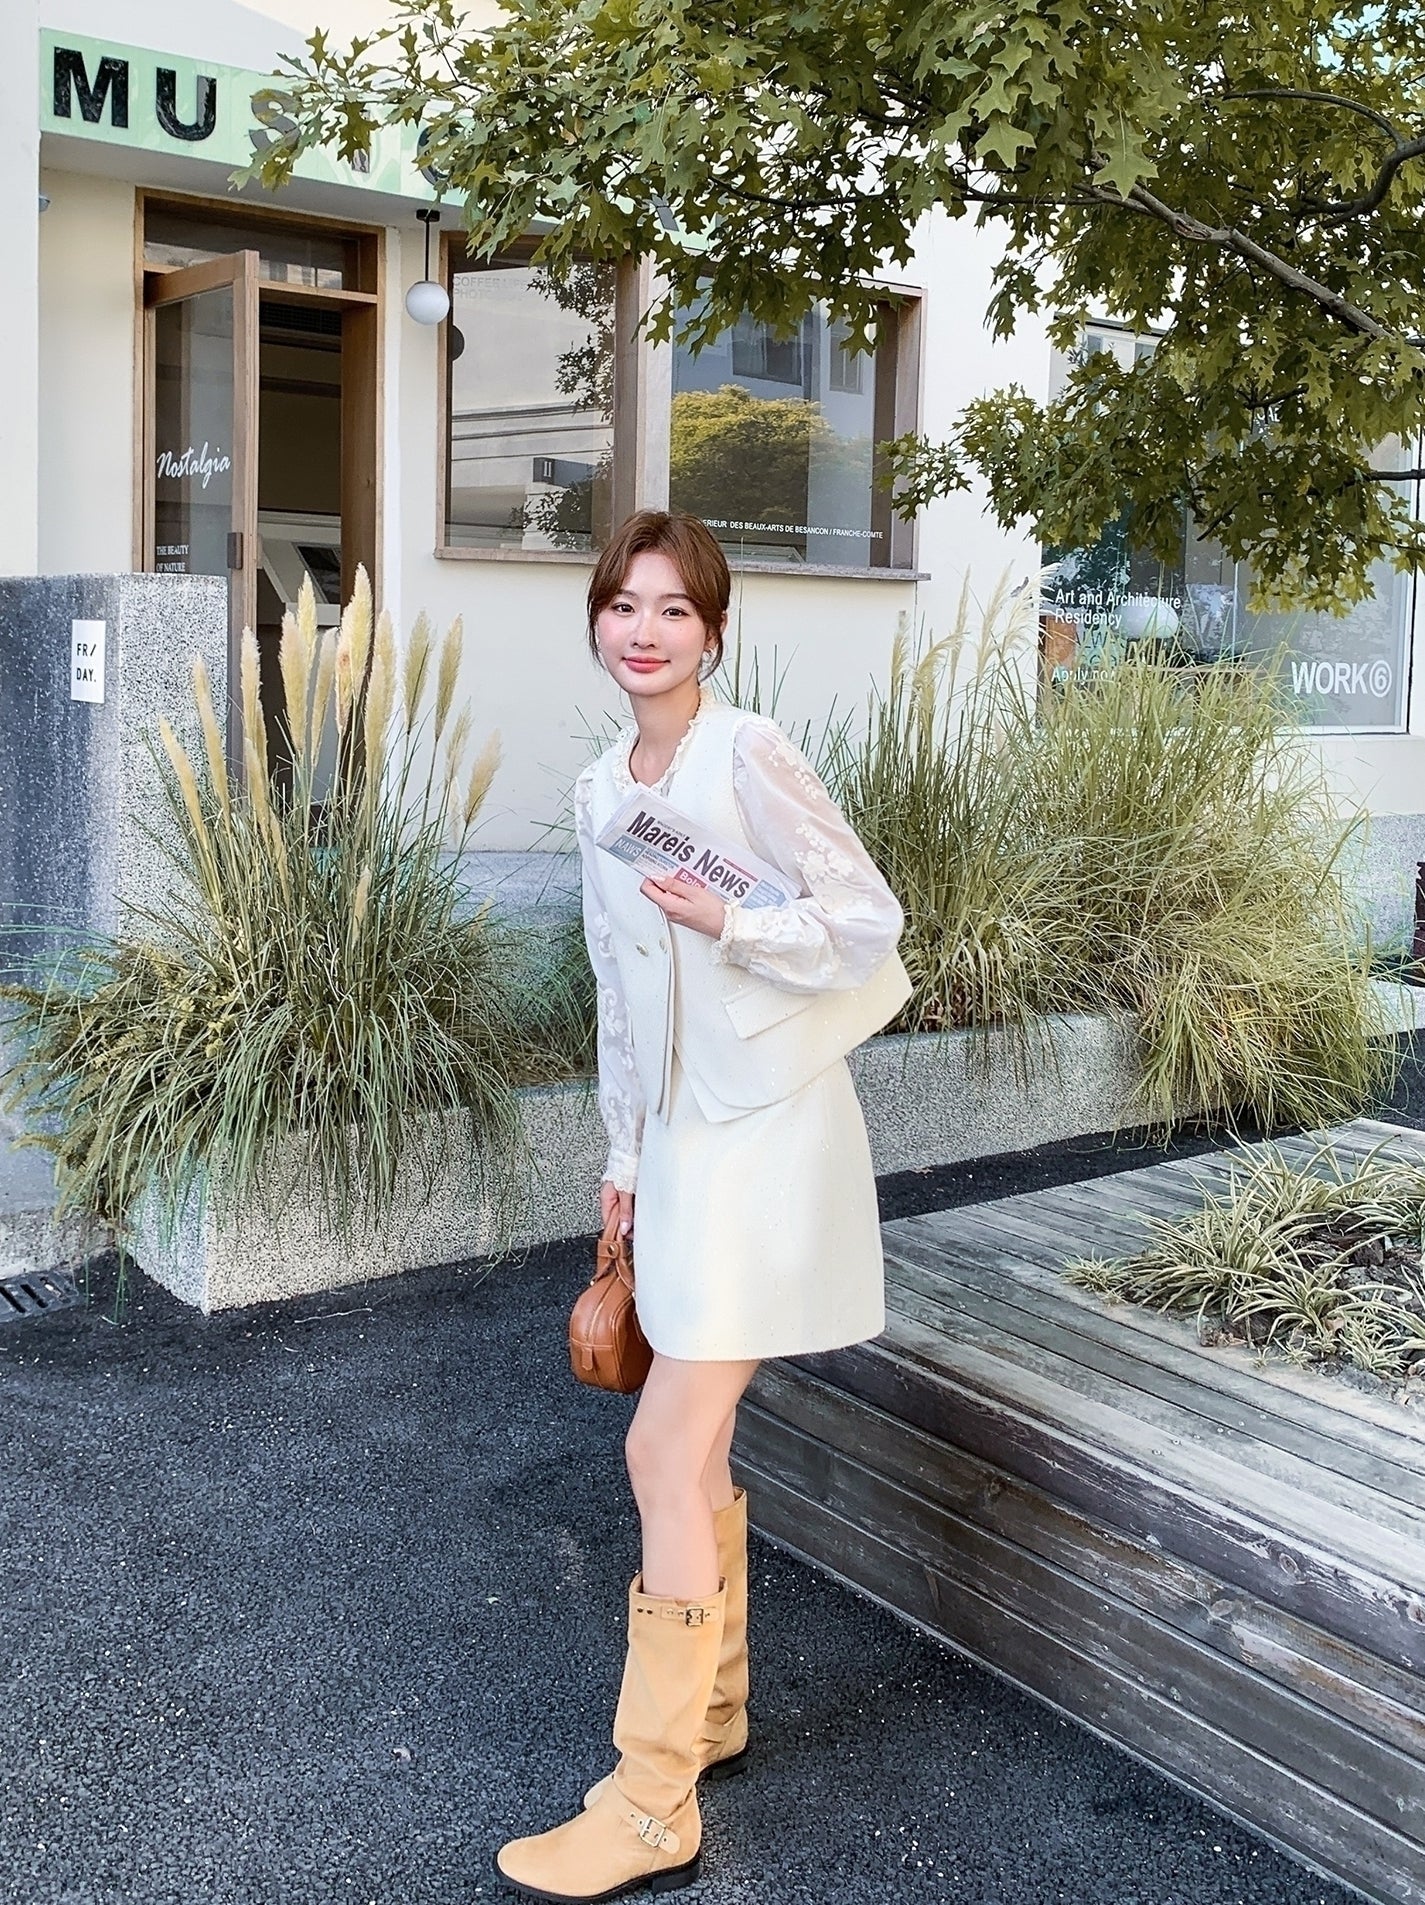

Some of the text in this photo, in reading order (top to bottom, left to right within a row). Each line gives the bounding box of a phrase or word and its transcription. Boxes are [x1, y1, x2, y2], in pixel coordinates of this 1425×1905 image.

[156, 441, 231, 489] Nostalgia
[730, 520, 743, 530] DES
[744, 522, 784, 533] BEAUX-ARTS
[785, 525, 794, 533] DE
[156, 544, 189, 556] THE BEAUTY
[156, 562, 185, 572] OF NATURE
[1055, 588, 1075, 605] Art
[1079, 590, 1102, 605] and
[1055, 607, 1122, 629] Residency
[76, 667, 97, 682] DAY.
[626, 811, 695, 863] Mareis
[693, 849, 750, 898] News
